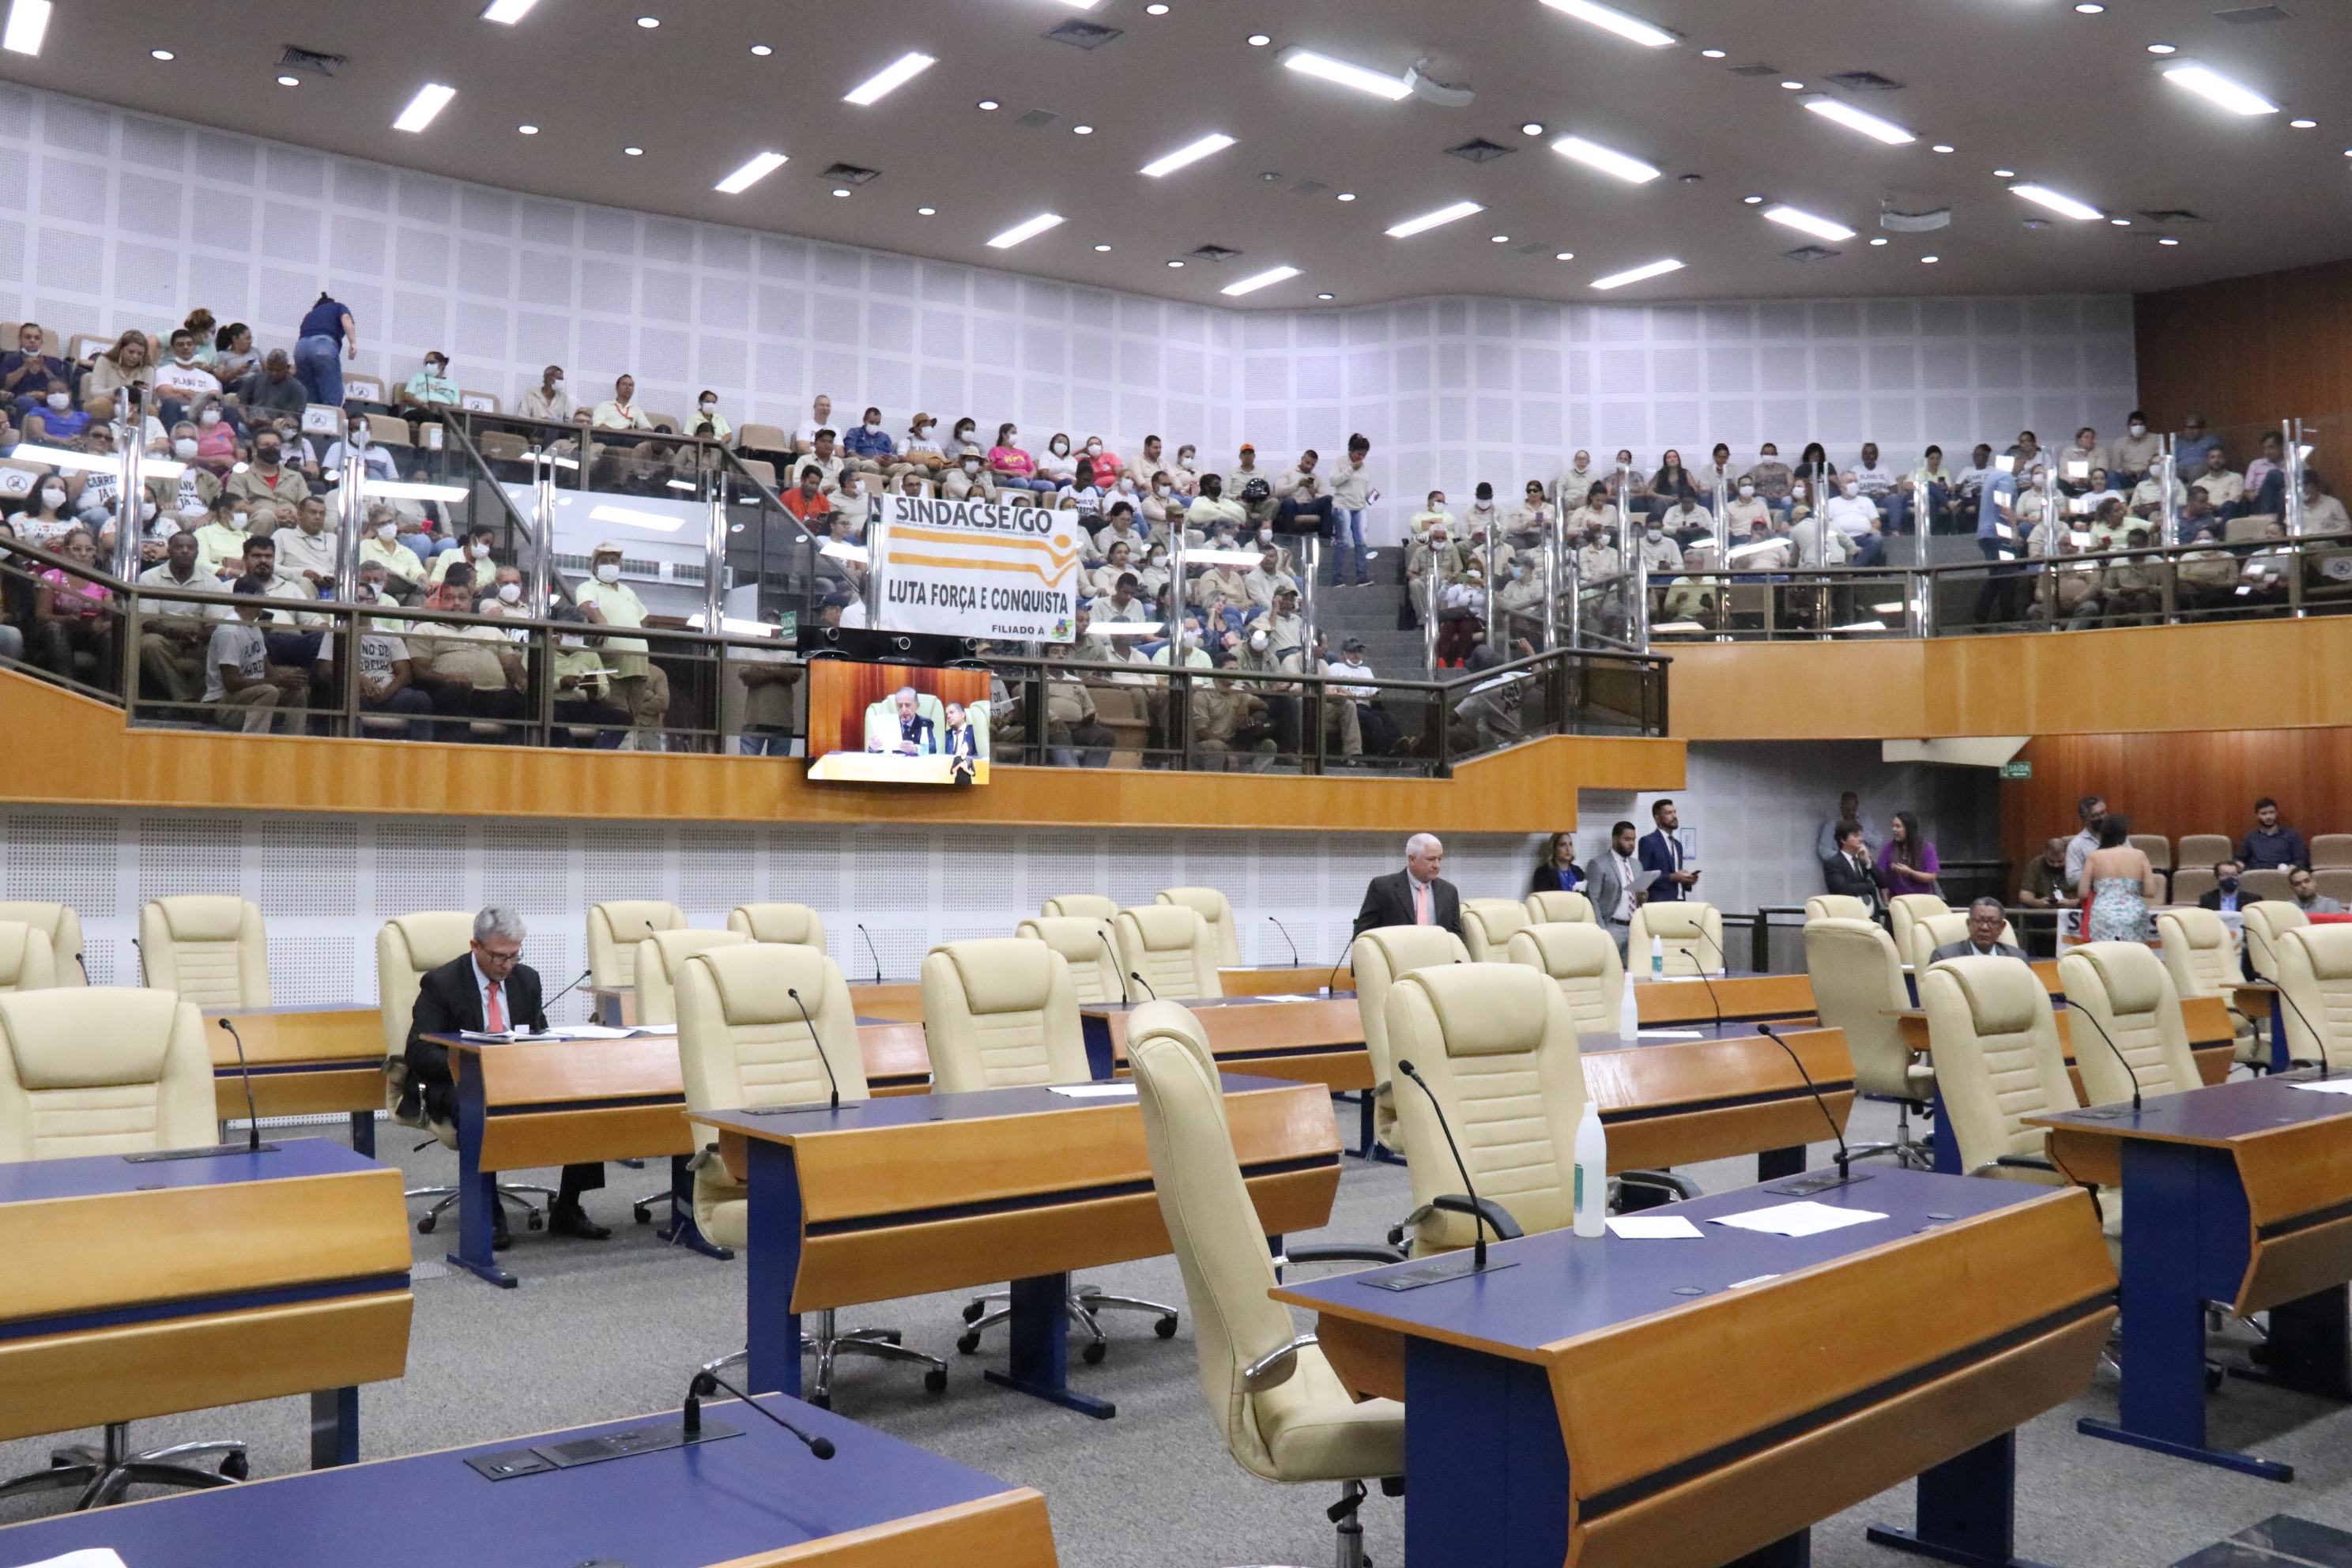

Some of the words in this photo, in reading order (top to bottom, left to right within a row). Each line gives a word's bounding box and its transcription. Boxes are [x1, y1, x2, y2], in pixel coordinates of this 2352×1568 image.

[87, 475, 117, 488] CARRE
[895, 497, 1052, 533] SINDACSE/GO
[888, 579, 926, 605] LUTA
[931, 583, 976, 614] FORÇA
[980, 587, 986, 609] E
[991, 588, 1069, 614] CONQUISTA
[992, 624, 1035, 635] FILIADO
[1038, 624, 1045, 635] À
